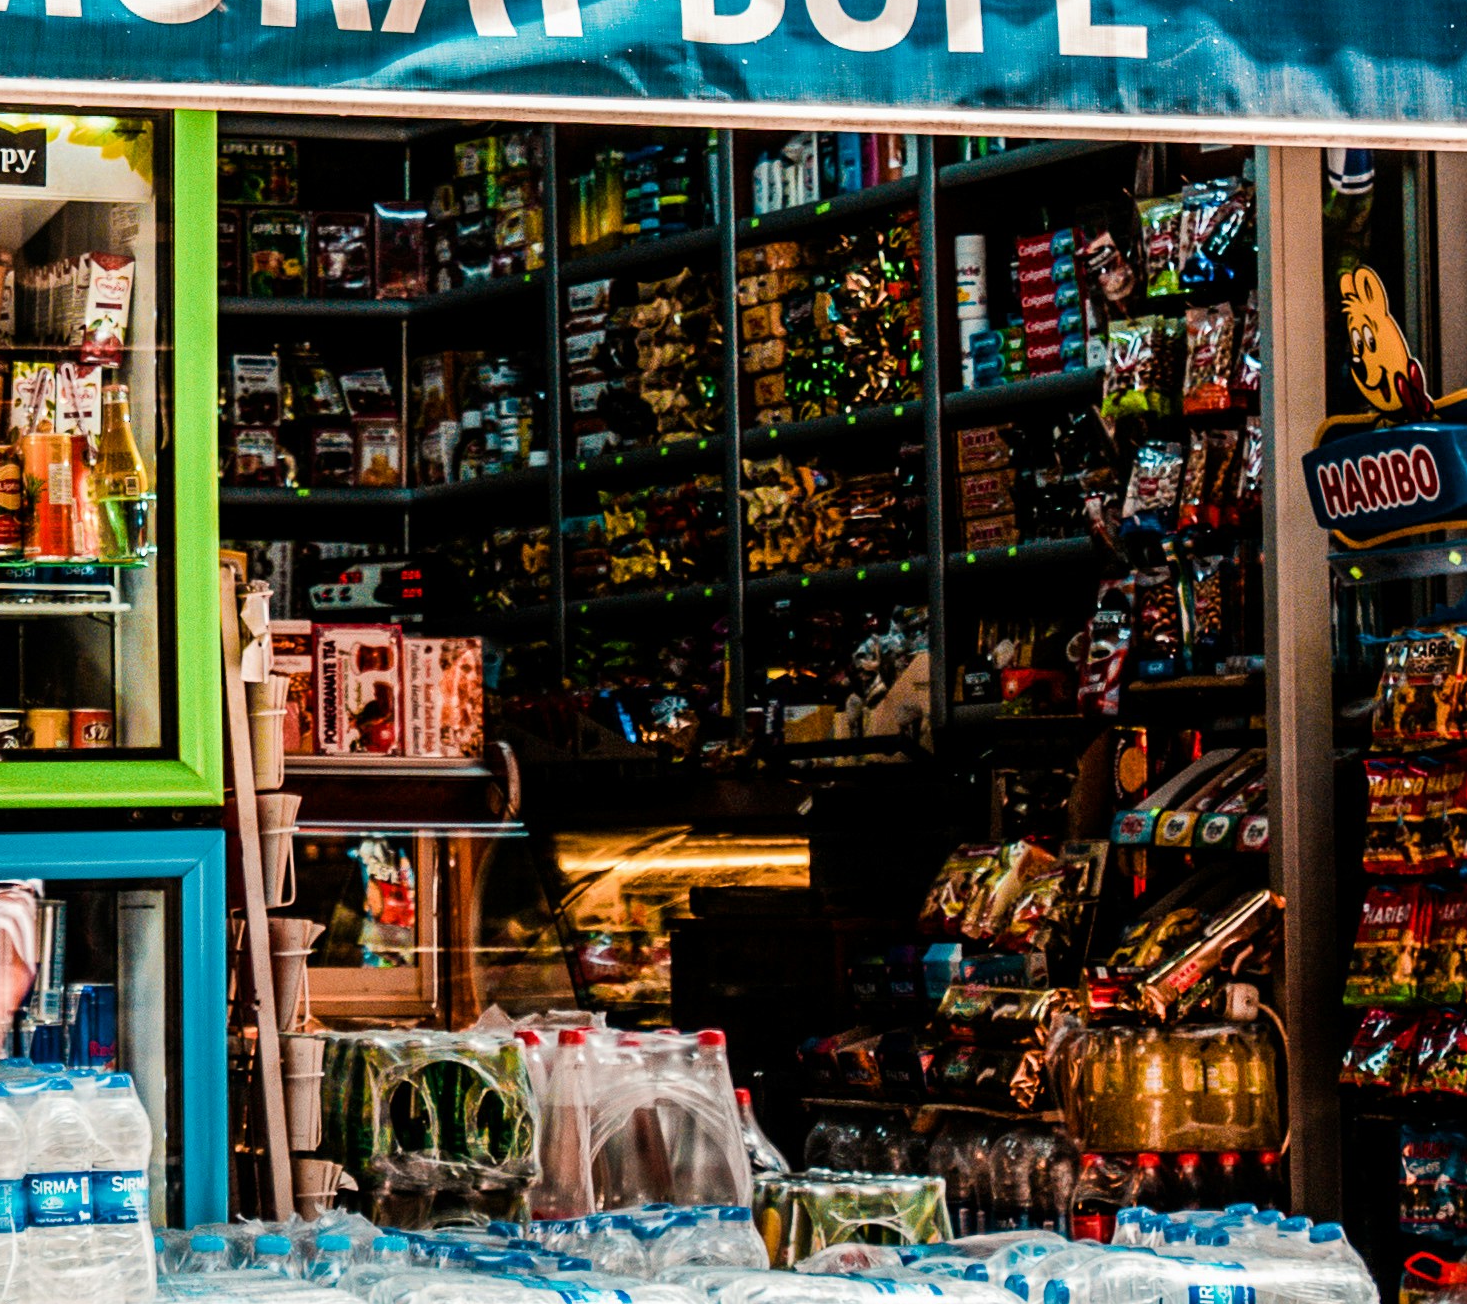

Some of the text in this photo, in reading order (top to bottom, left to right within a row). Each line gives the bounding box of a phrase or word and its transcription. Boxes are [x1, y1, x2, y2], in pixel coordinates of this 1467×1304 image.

[1317, 444, 1439, 520] HARIBO
[31, 1177, 80, 1196] SIRMA
[111, 1175, 147, 1194] SIRM
